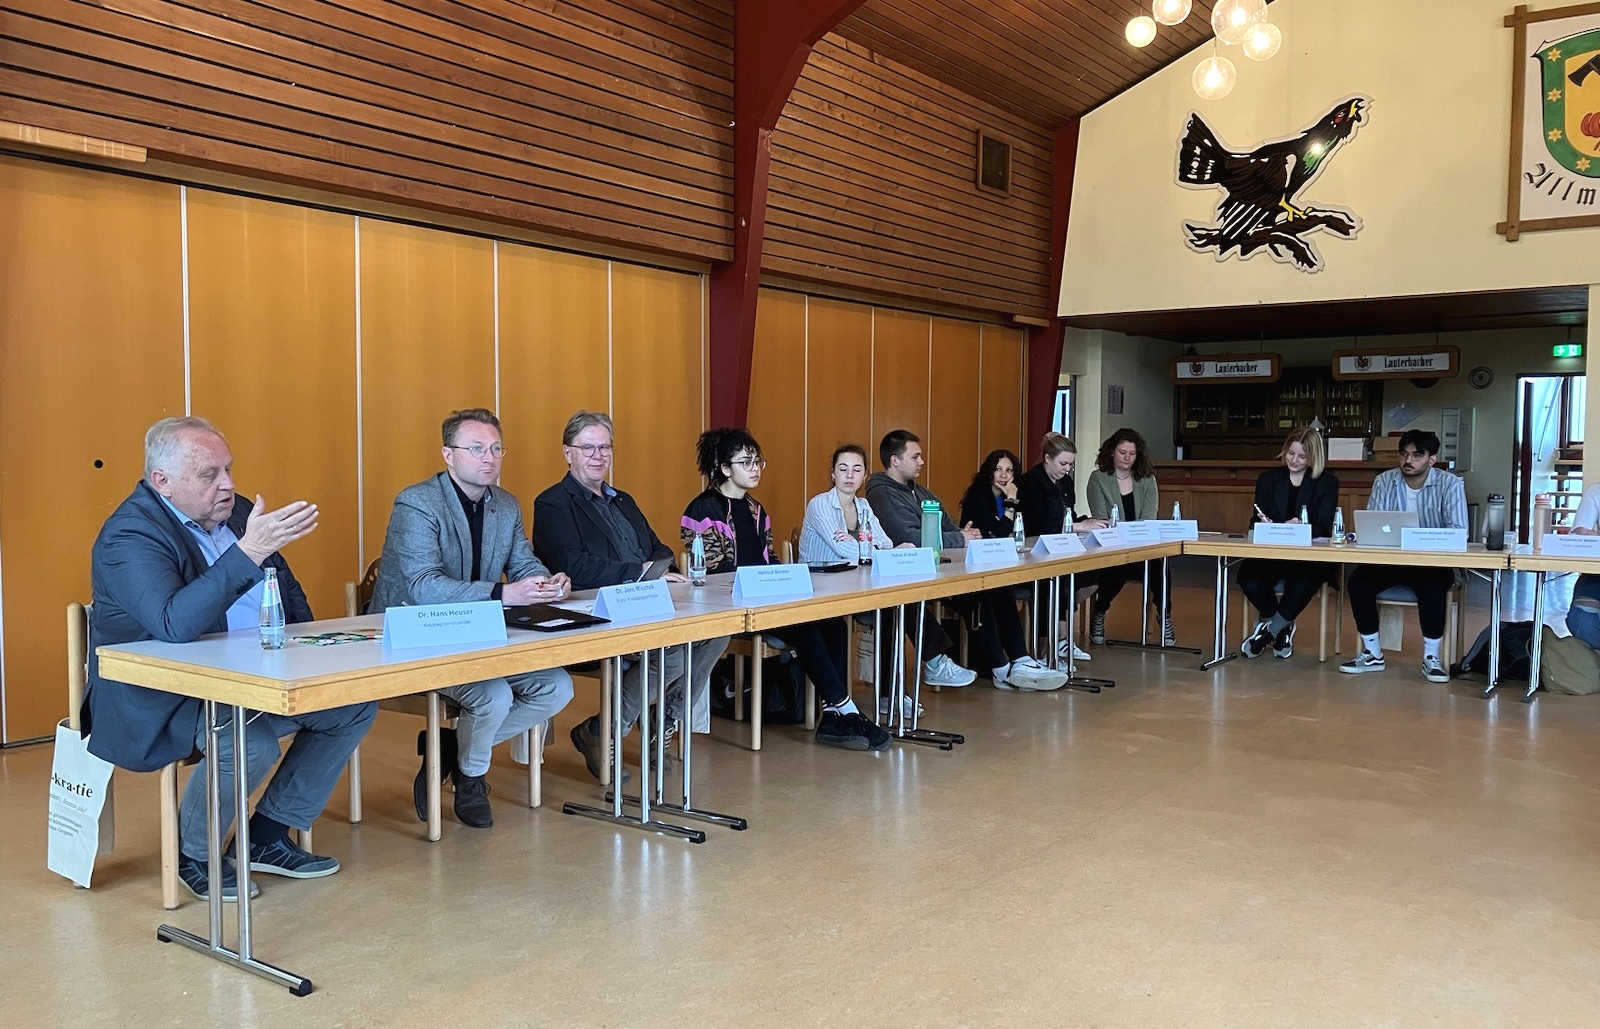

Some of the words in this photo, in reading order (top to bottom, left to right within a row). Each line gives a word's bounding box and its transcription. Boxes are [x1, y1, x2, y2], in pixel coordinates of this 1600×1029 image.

[1215, 362, 1258, 374] Lauterbacher
[1384, 356, 1434, 368] Lauterbacher
[418, 611, 429, 619] Dr.
